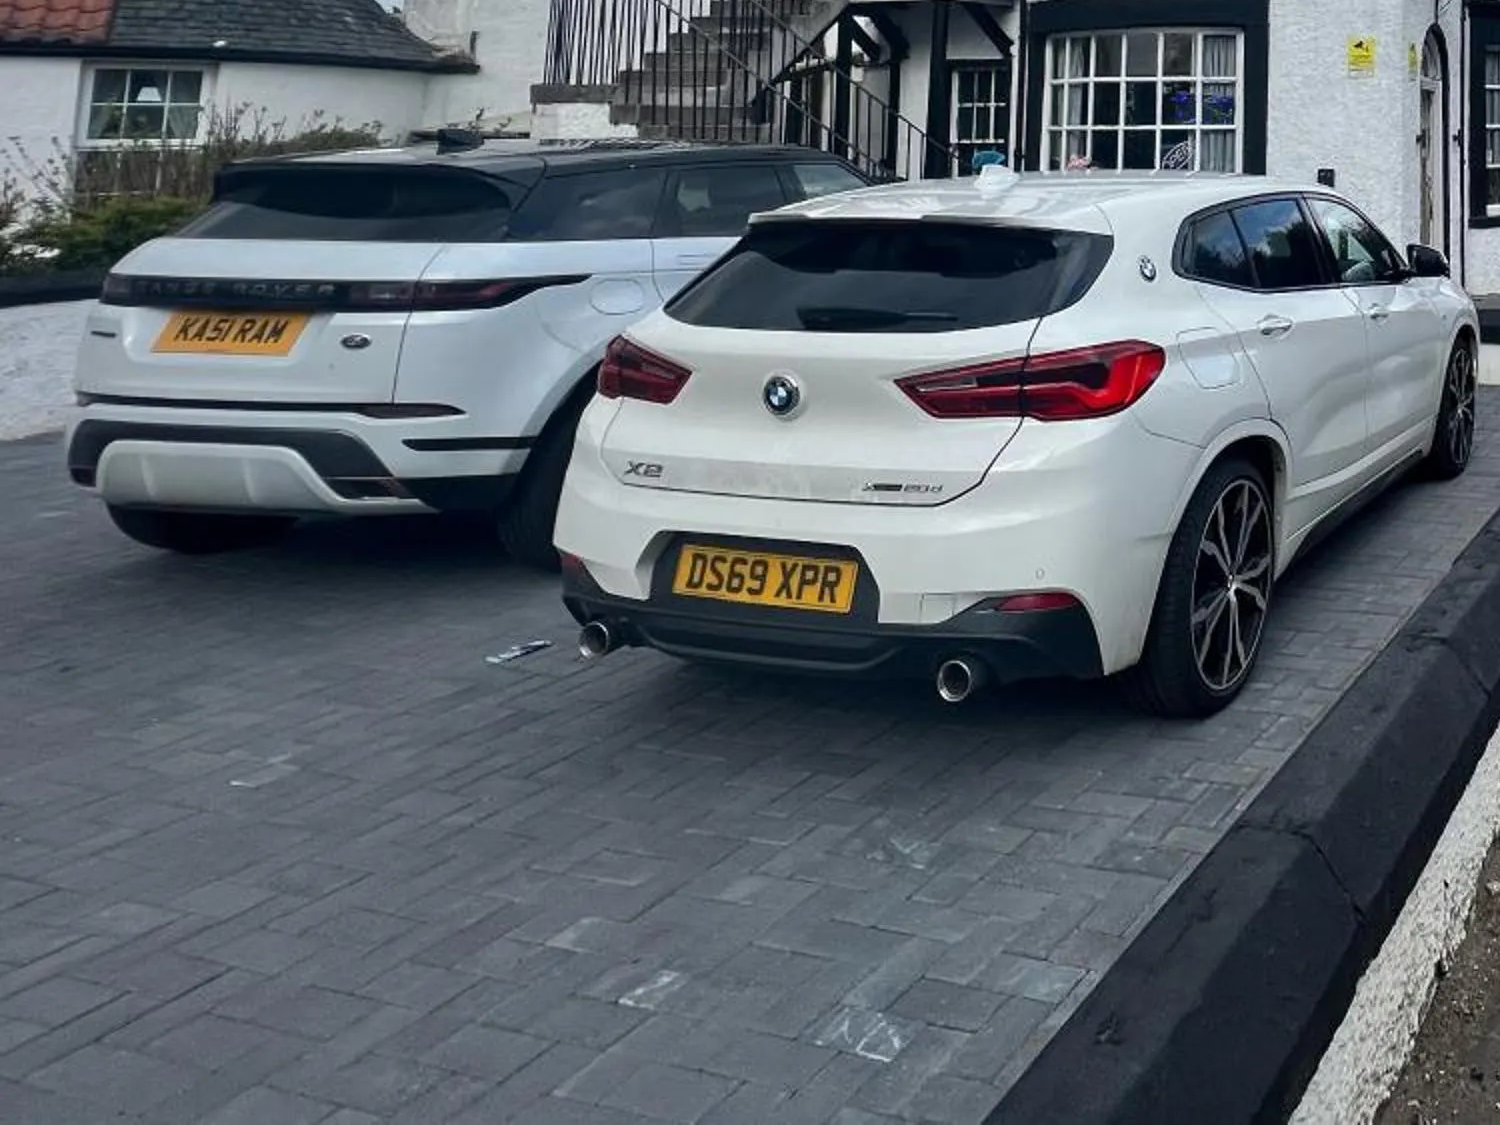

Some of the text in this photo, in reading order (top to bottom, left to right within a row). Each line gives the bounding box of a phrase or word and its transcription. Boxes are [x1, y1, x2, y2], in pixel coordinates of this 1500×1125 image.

[231, 281, 336, 299] ROVER
[232, 318, 289, 344] RAM
[623, 460, 664, 478] X2
[685, 552, 842, 604] DS69 XPR
